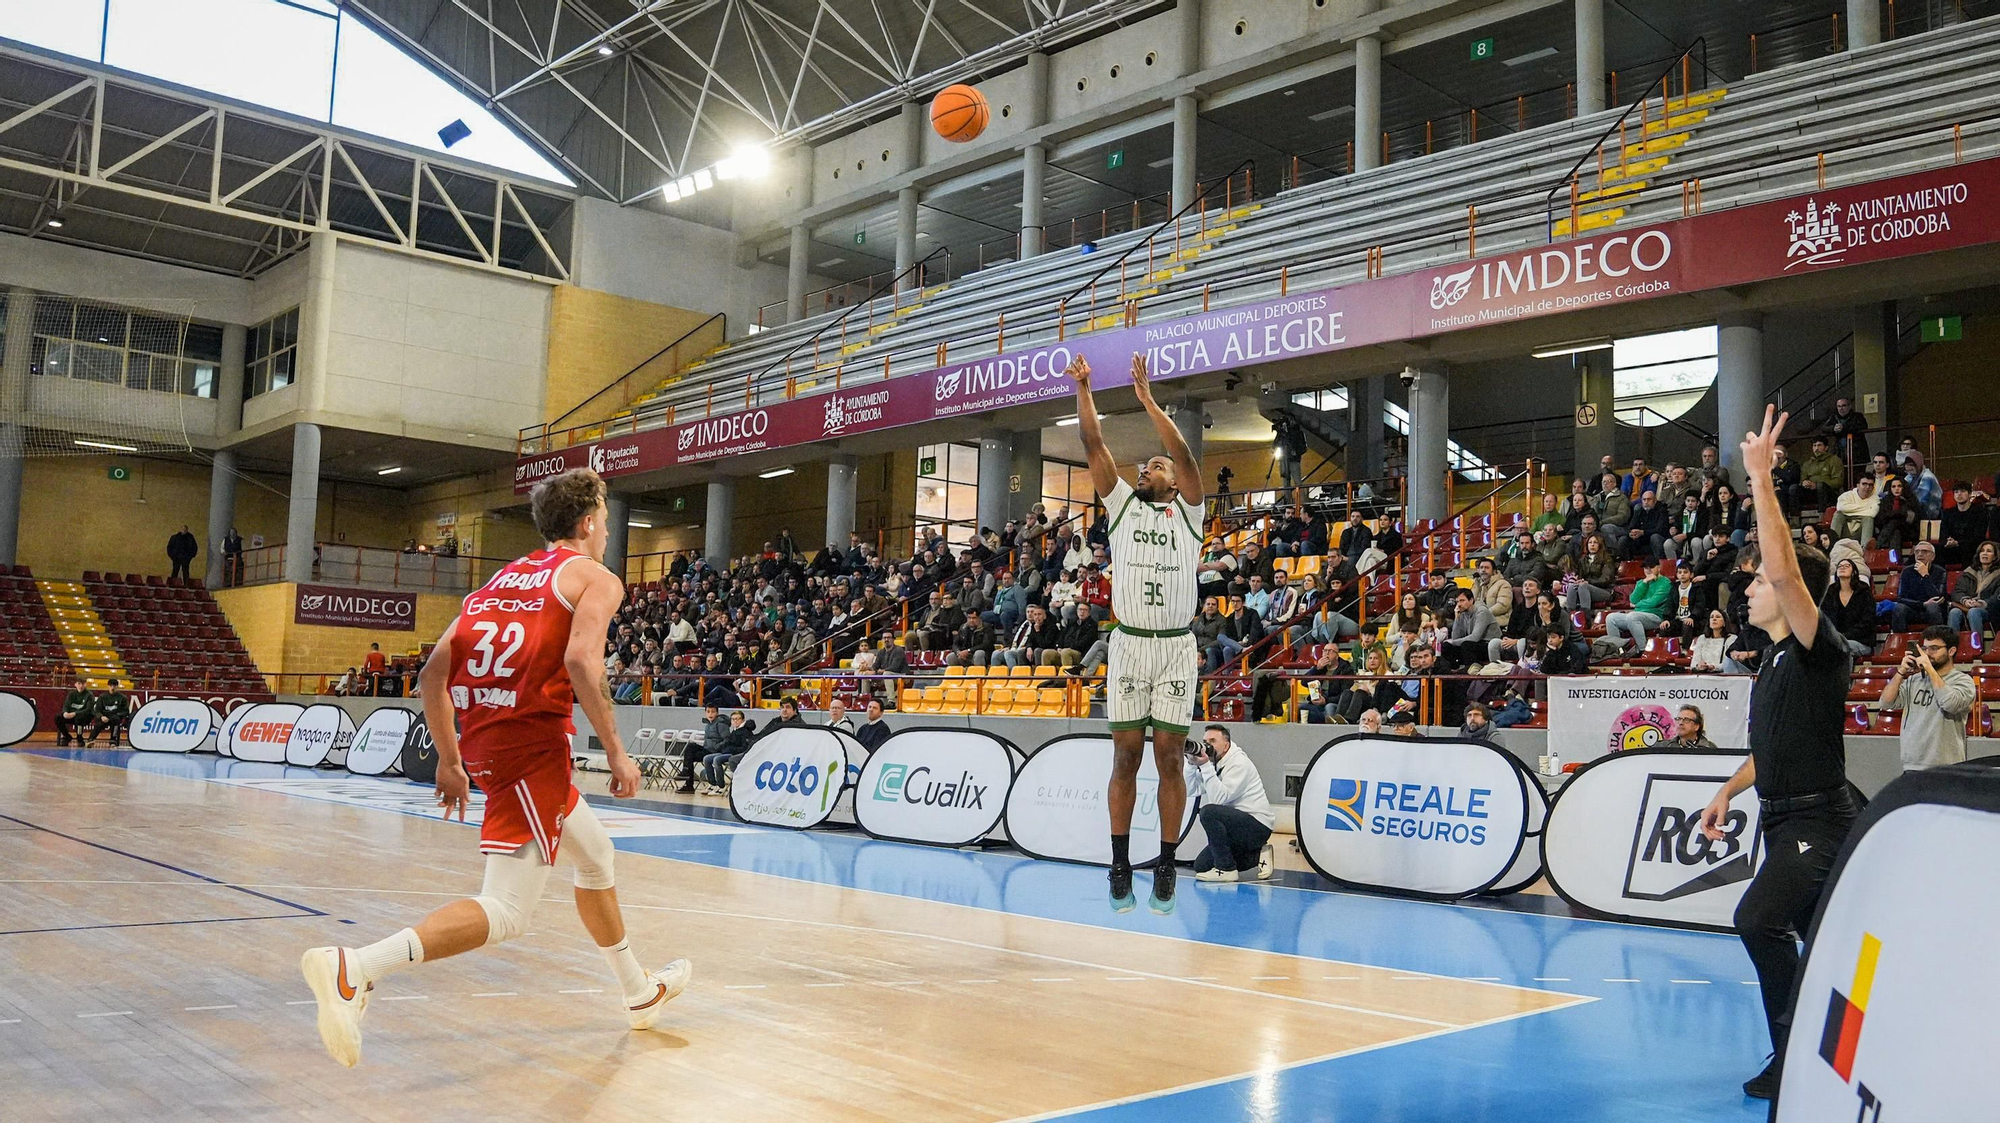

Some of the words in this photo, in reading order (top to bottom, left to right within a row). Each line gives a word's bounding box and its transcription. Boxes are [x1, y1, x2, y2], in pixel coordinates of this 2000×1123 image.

[1477, 43, 1486, 56] 8
[1112, 154, 1118, 166] 7
[1846, 182, 1968, 223] AYUNTAMIENTO
[857, 235, 862, 244] 6
[1847, 226, 1867, 247] DE
[1870, 211, 1950, 243] CÓRDOBA
[1481, 230, 1671, 300] IMDECO
[1431, 314, 1476, 329] Instituto
[1478, 302, 1534, 321] Municipal
[1537, 299, 1553, 311] de
[1556, 290, 1612, 308] Deportes
[1615, 279, 1671, 298] Córdoba
[1145, 322, 1194, 343] PALACIO
[1196, 309, 1261, 333] MUNICIPAL
[1264, 295, 1327, 318] DEPORTES
[1221, 311, 1346, 364] ALEGRE
[964, 347, 1071, 395] IMDECO
[845, 390, 889, 410] AYUNTAMIENTO
[935, 404, 961, 416] Instituto
[962, 398, 994, 411] Municipal
[995, 395, 1004, 404] de
[1005, 390, 1038, 403] Deportes
[1038, 384, 1070, 397] Córdoba
[845, 412, 853, 425] DE
[853, 407, 882, 423] CÓRDOBA
[697, 410, 768, 447] IMDECO
[606, 444, 639, 460] Diputación
[695, 449, 717, 460] Municipal
[724, 444, 746, 455] Deportes
[745, 441, 767, 451] Córdoba
[526, 456, 565, 478] IMDECO
[606, 461, 614, 472] de
[614, 456, 639, 470] Córdoba
[924, 460, 931, 472] G
[676, 498, 682, 508] F
[1133, 529, 1168, 546] coto
[1127, 561, 1155, 569] Fundación
[300, 612, 324, 620] Instituto
[325, 614, 353, 622] Municipal
[327, 595, 412, 617] IMDECO
[466, 621, 525, 678] 32
[1568, 686, 1657, 699] INVESTIGACIÓN
[1668, 688, 1729, 700] SOLUCIÓN
[141, 710, 199, 735] simon
[1630, 712, 1646, 723] LA
[755, 757, 819, 796] coto
[904, 766, 988, 810] Cualix
[1037, 785, 1100, 801] CLÍNICA
[1374, 781, 1492, 819] REALE
[1371, 815, 1486, 846] SEGUROS
[1641, 806, 1748, 866] RG3
